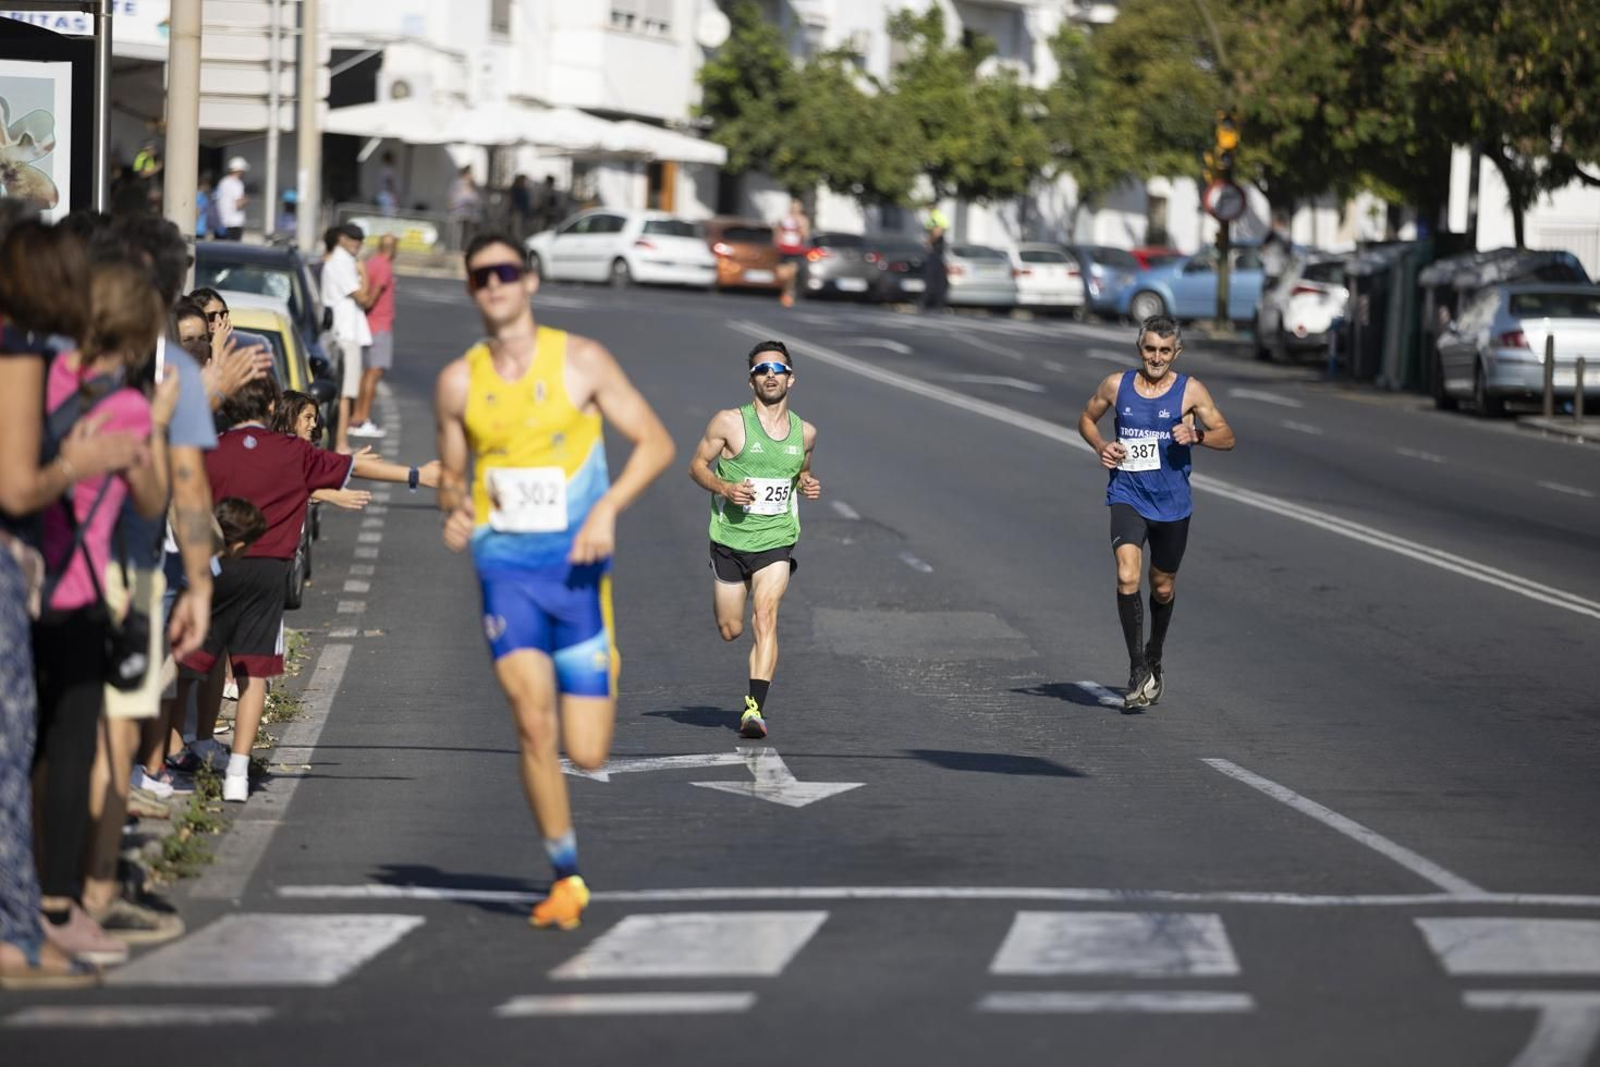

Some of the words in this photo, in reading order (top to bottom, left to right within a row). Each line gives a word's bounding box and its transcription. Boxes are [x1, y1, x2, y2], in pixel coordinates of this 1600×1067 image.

[1121, 427, 1171, 440] TROTASIERRA
[1131, 443, 1156, 459] 387
[517, 481, 558, 506] 302
[765, 485, 789, 502] 255
